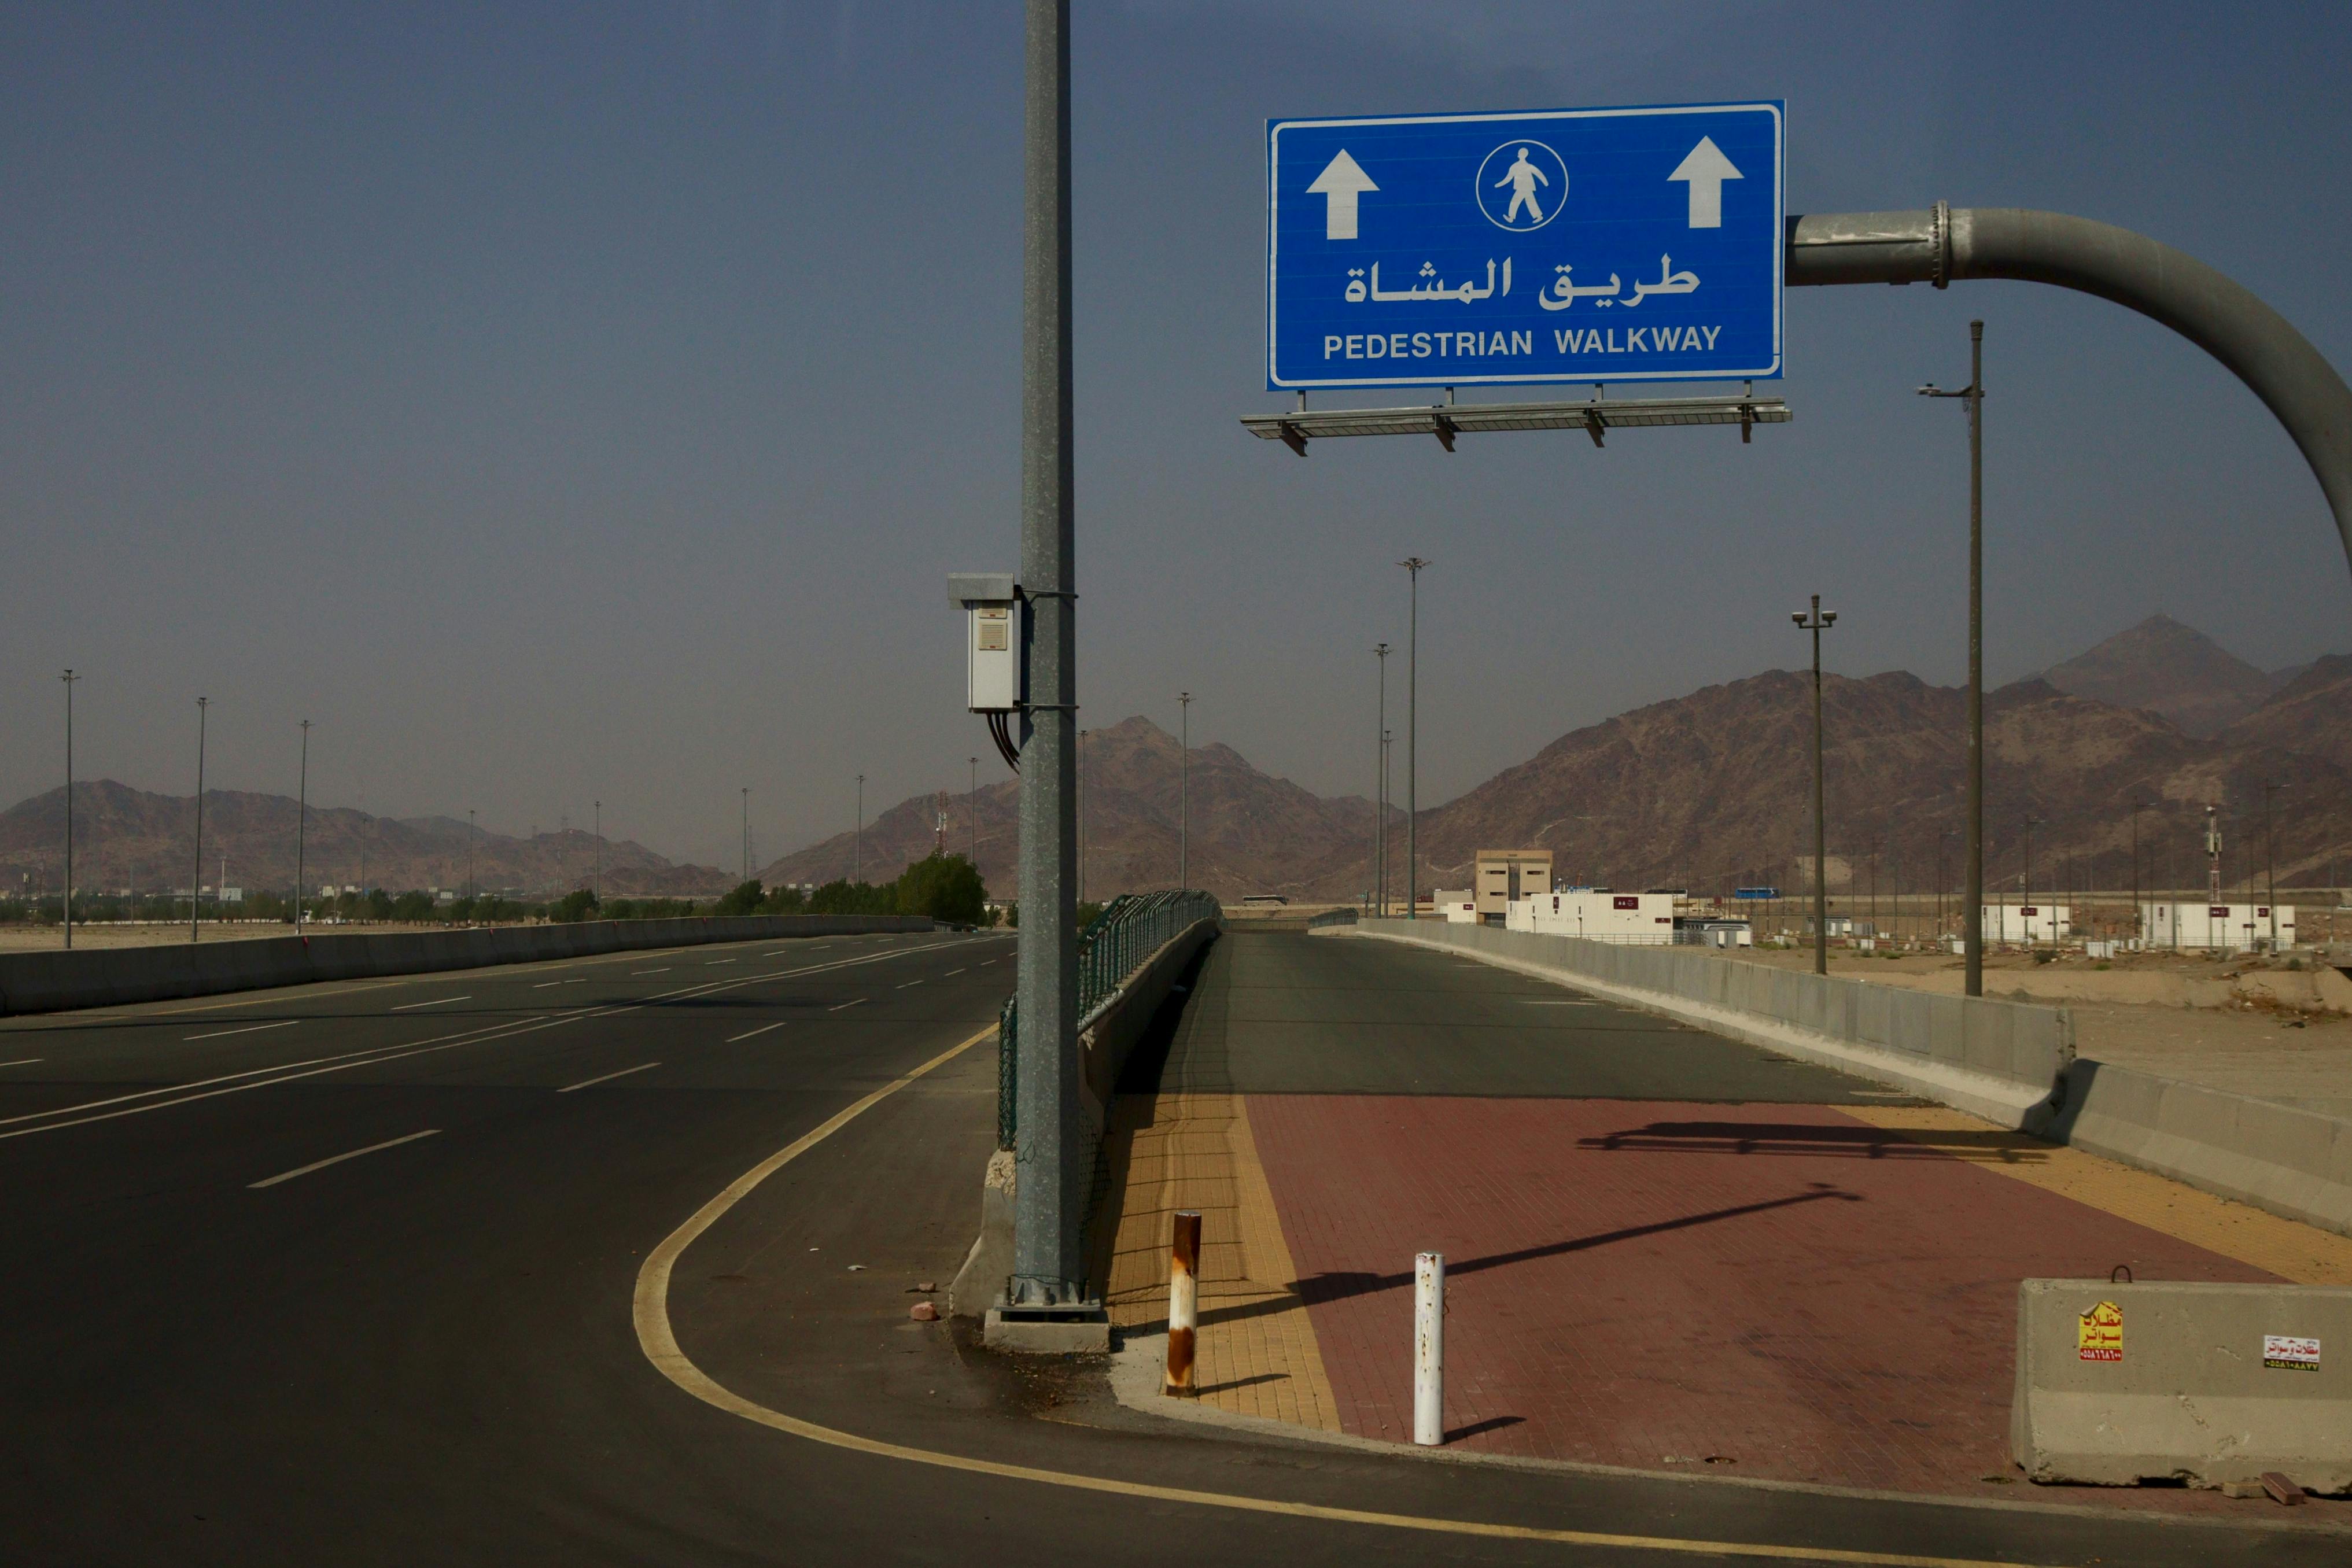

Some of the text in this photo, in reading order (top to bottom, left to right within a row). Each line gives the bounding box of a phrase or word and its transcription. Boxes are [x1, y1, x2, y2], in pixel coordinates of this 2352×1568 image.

[1344, 253, 1701, 311] طريق المشاة
[1325, 326, 1721, 359] PEDESTRIAN WALKWAY
[2083, 1328, 2121, 1344] سواتر
